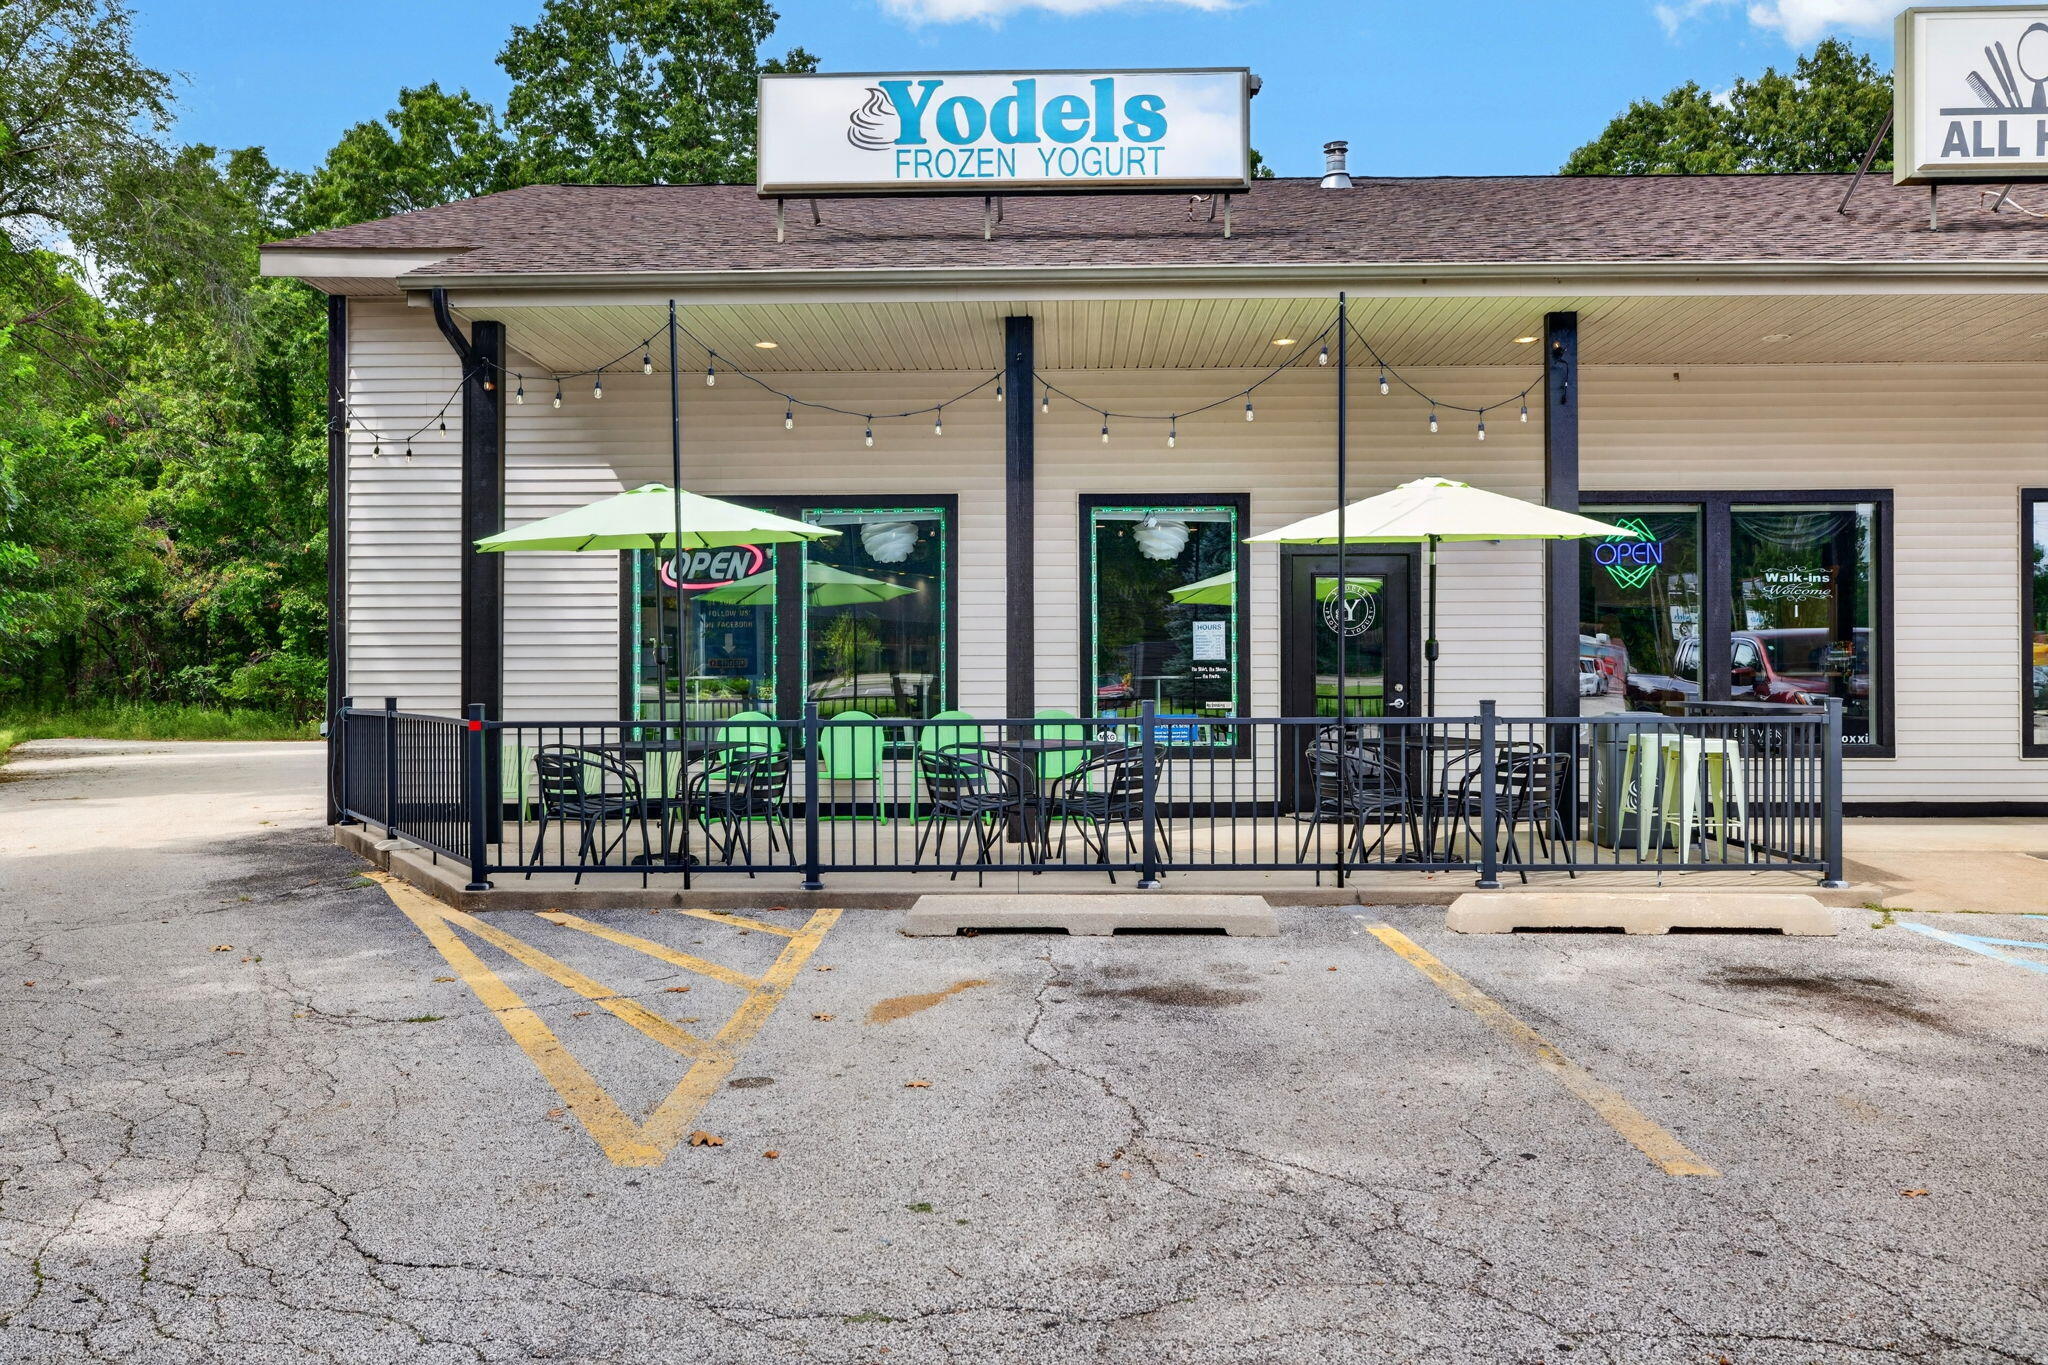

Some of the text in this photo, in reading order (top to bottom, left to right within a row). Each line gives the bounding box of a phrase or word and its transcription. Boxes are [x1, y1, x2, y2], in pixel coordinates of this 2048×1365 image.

[878, 78, 1168, 145] Yodels
[1940, 120, 2020, 157] ALL
[896, 146, 1165, 178] FROZEN YOGURT
[668, 552, 752, 580] OPEN
[1595, 542, 1663, 565] OPEN
[1762, 583, 1832, 595] Welcome
[1765, 572, 1830, 583] Walk-ins
[1842, 733, 1869, 744] oxxi
